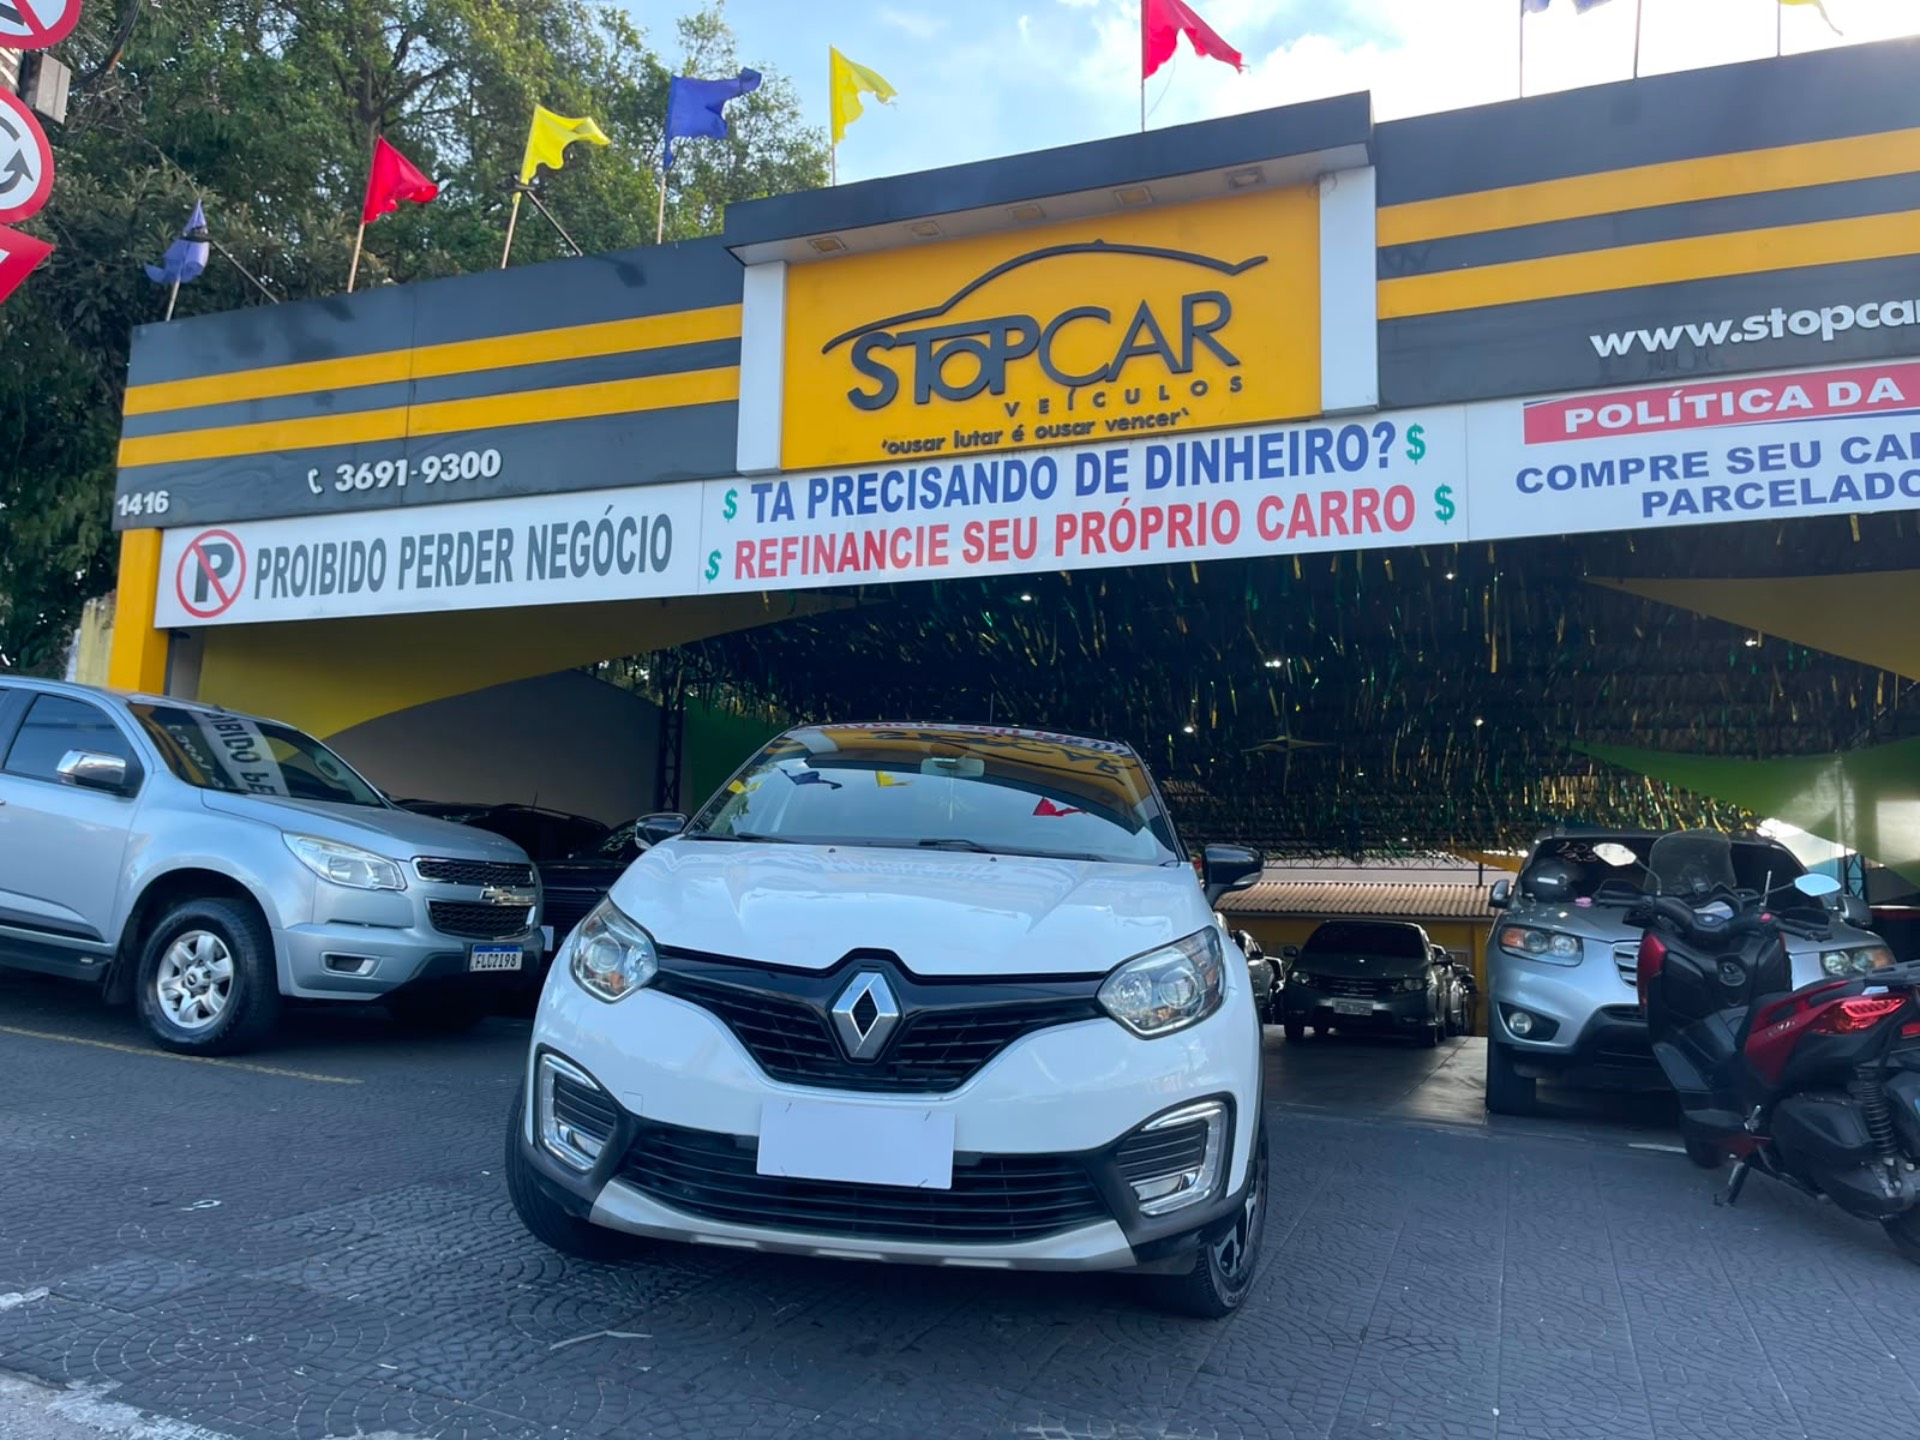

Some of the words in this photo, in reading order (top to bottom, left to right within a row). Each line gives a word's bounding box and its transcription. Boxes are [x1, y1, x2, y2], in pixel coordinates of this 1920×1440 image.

[847, 290, 1240, 411] STOPCAR
[1004, 375, 1243, 418] VEÍCULOS
[1564, 385, 1813, 434] POLÍTICA
[1827, 377, 1906, 408] DA
[953, 429, 1004, 450] lutar
[1011, 424, 1025, 443] é
[1035, 420, 1096, 439] ousar
[335, 448, 502, 492] 3691-9300
[751, 480, 796, 524] TA
[807, 455, 1058, 520] PRECISANDO
[1075, 448, 1129, 497] DE
[1145, 420, 1396, 490] DINHEIRO?
[1515, 450, 1710, 494] COMPRE
[1726, 440, 1822, 475] SEU
[117, 490, 170, 517] 1416
[254, 537, 388, 600] PROIBIDO
[398, 527, 514, 590] PERDER
[526, 504, 673, 582] NEGÓCIO
[734, 523, 949, 580] REFINANCIE
[962, 515, 1039, 564] SEU
[1055, 497, 1241, 557] PRÓPRIO
[1256, 484, 1416, 542] CARRO
